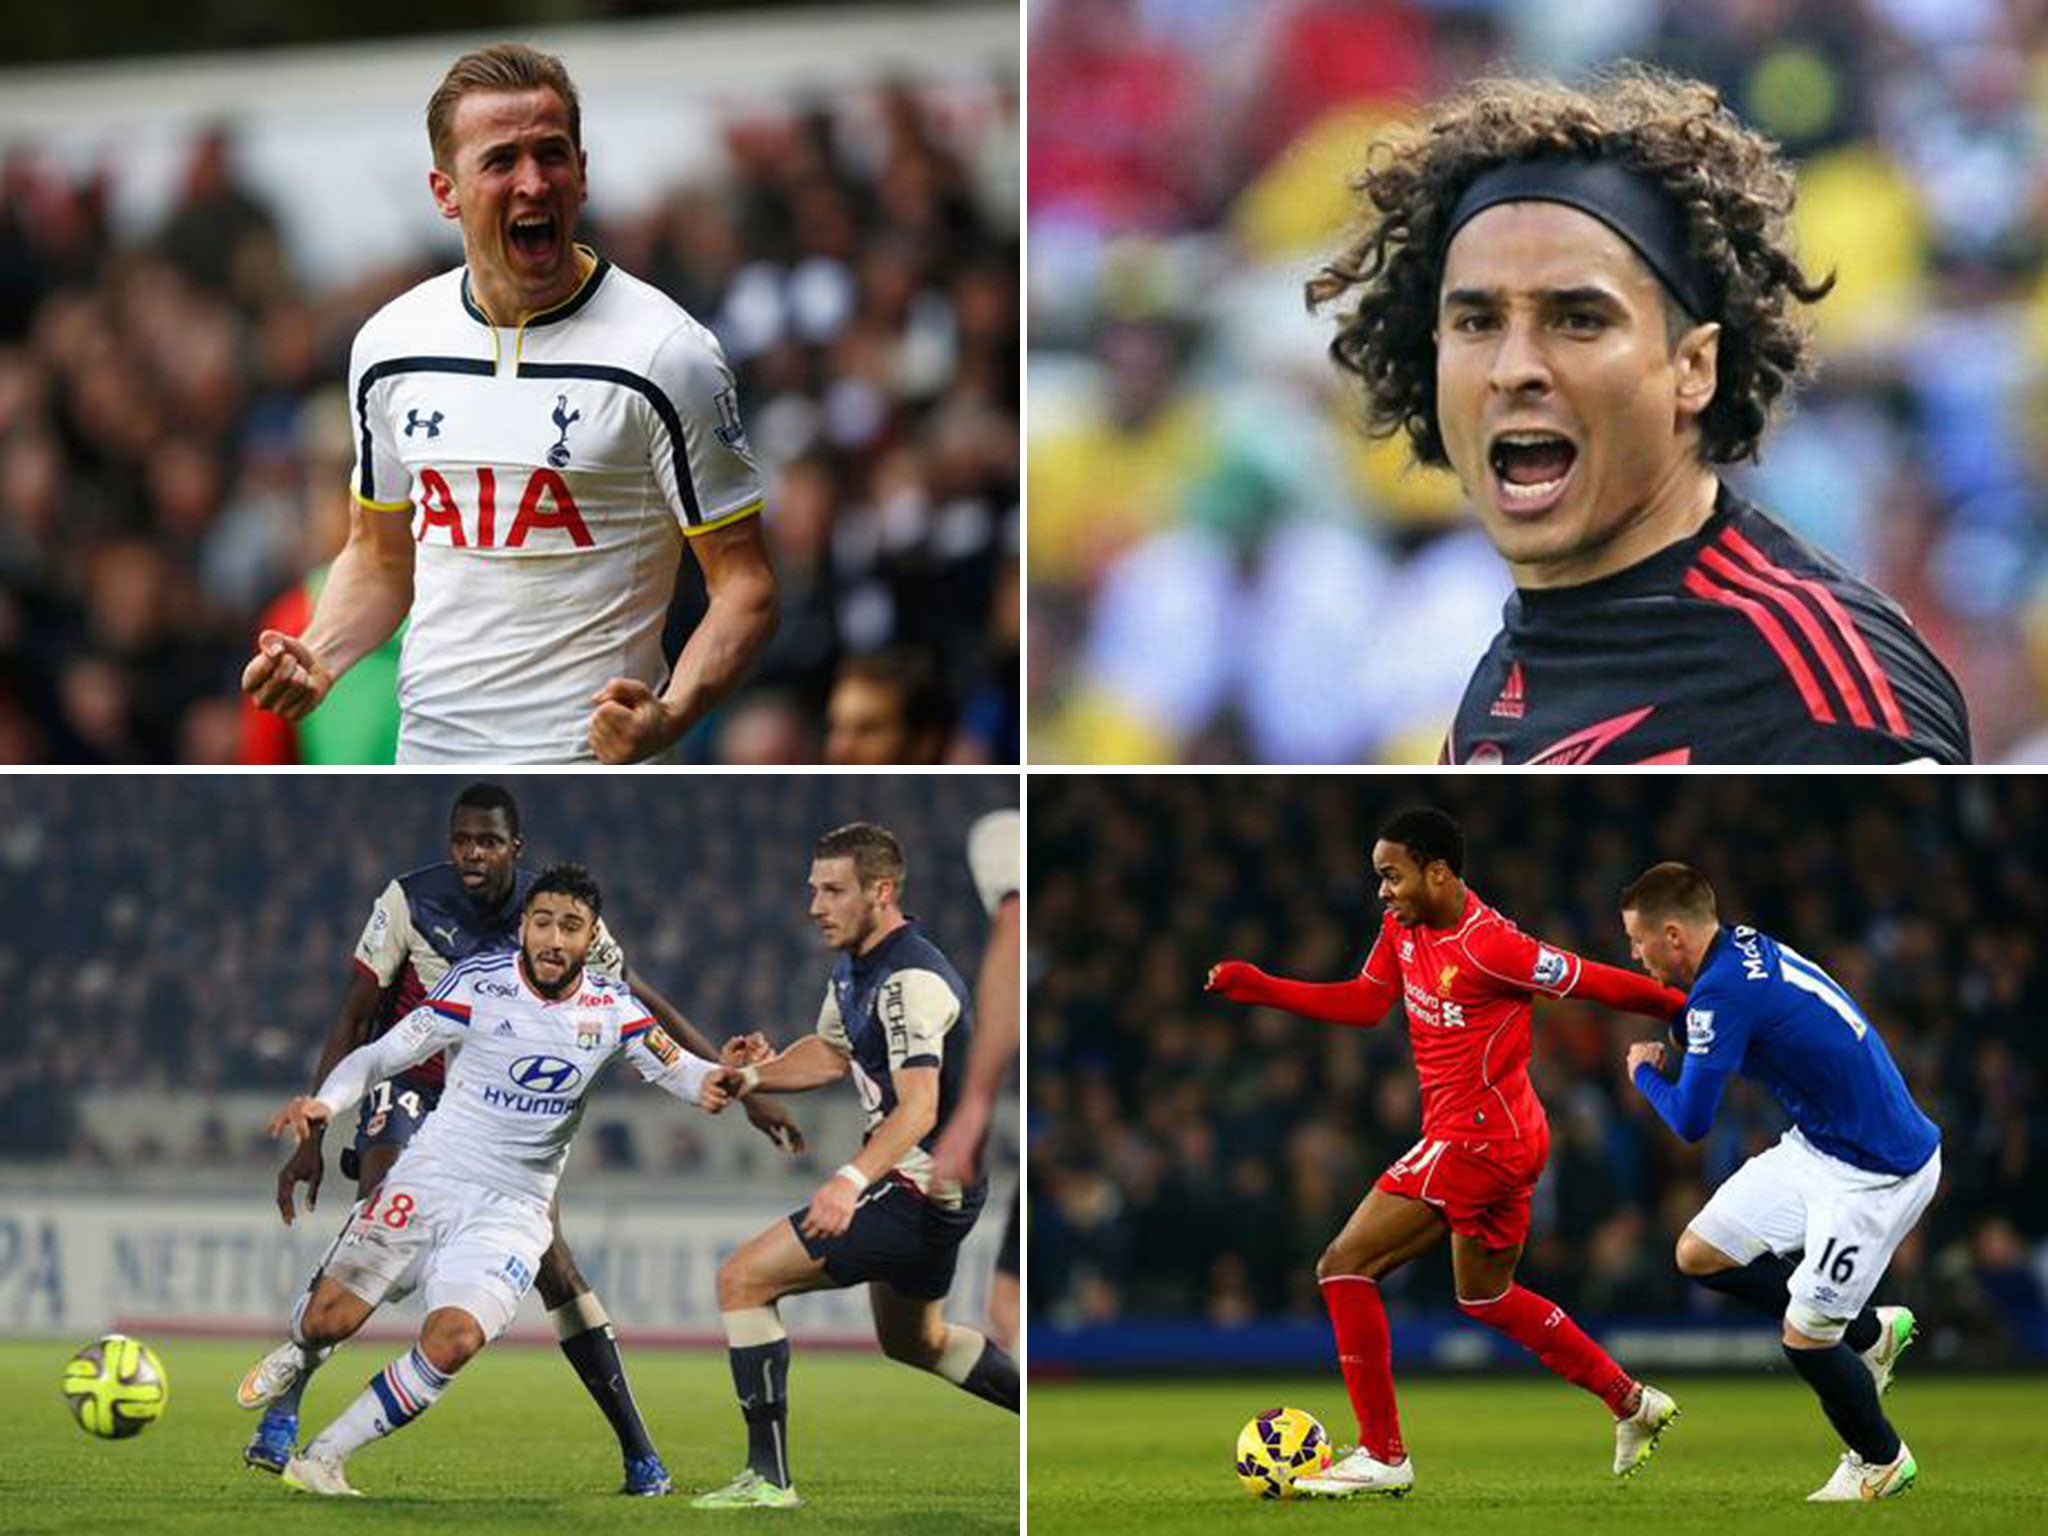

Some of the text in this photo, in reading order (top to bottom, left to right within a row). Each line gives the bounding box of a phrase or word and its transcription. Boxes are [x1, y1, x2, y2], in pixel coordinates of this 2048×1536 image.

[416, 467, 596, 548] AIA
[884, 982, 908, 1055] PICHET
[374, 1080, 420, 1119] 14
[484, 1086, 580, 1115] HYUNDA
[362, 1187, 414, 1228] 18
[1818, 1237, 1859, 1285] 16
